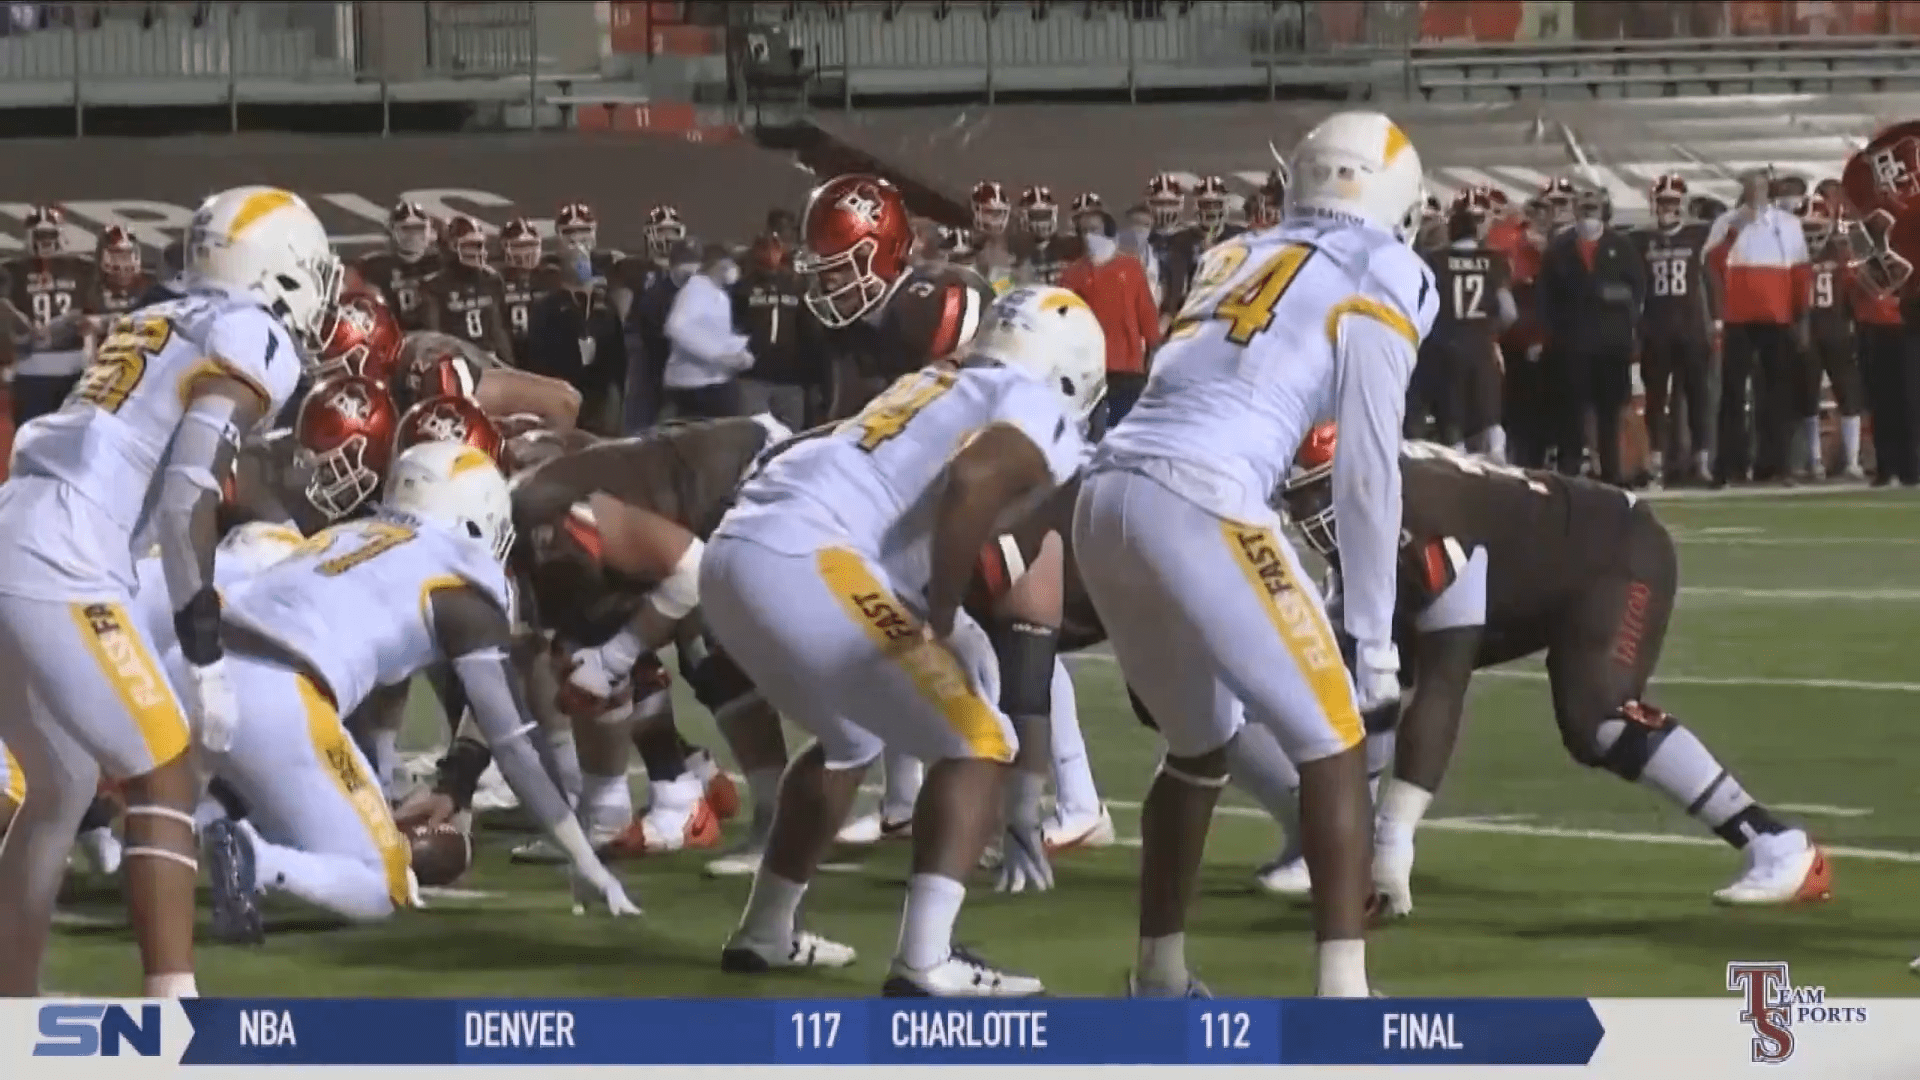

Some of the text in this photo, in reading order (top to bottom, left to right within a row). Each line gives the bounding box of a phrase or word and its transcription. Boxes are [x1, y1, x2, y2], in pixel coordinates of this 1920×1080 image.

[1167, 240, 1318, 347] 24
[1453, 274, 1487, 319] 12
[1652, 259, 1688, 296] 88
[466, 308, 482, 338] 8
[1237, 532, 1296, 597] FAST
[83, 604, 121, 638] FA
[852, 592, 913, 641] FAST
